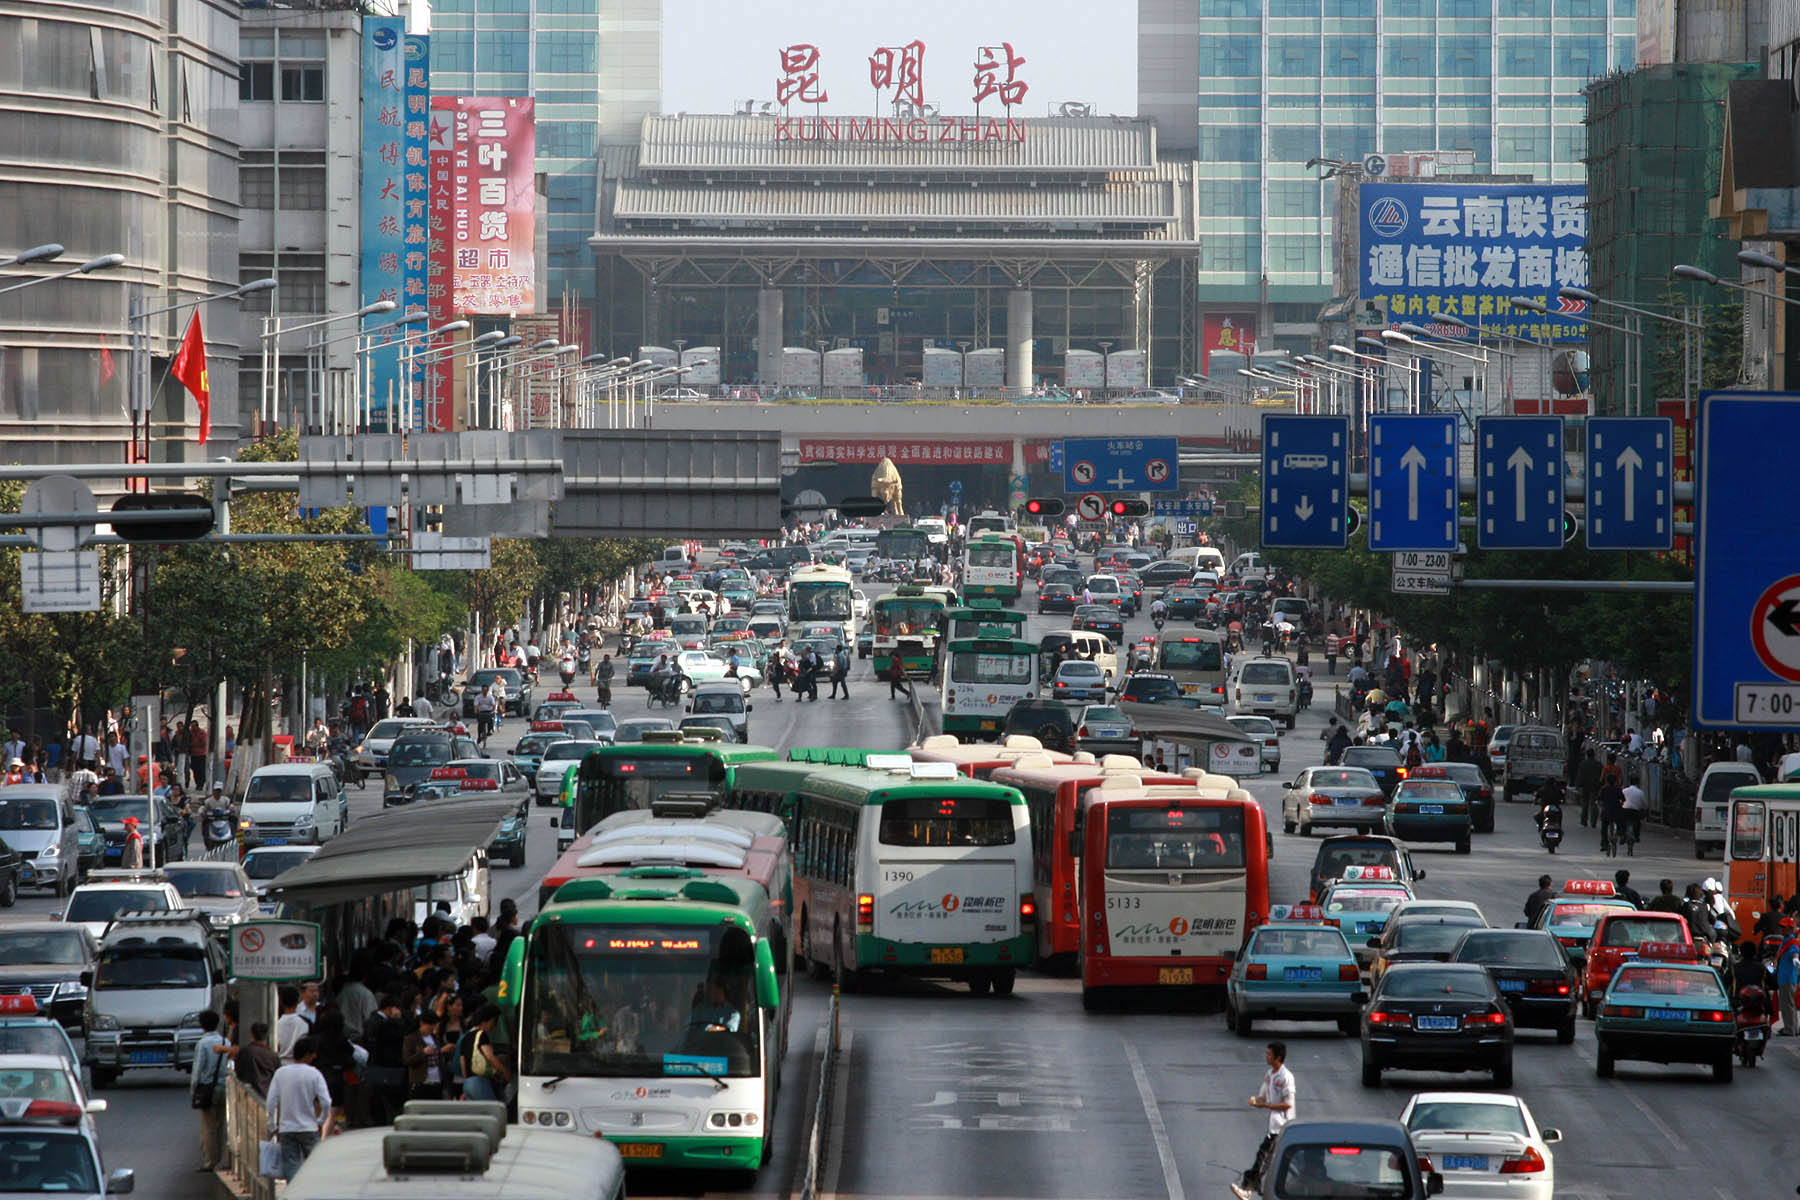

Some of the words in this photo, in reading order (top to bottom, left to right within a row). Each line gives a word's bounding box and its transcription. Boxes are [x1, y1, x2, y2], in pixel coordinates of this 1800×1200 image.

[776, 40, 1029, 107] 昆明站
[456, 112, 468, 141] SAN
[776, 118, 840, 142] KUN
[850, 118, 928, 142] MING
[939, 118, 1026, 142] ZHAN
[456, 150, 468, 168] YE
[478, 110, 508, 240] 三叶百货
[456, 176, 468, 202] BAI
[456, 209, 468, 240] HUO
[1420, 196, 1588, 238] 云南联贸
[458, 249, 510, 269] 超市
[1369, 244, 1589, 288] 通信批发商城
[1374, 294, 1547, 316] 场内有大型茶叶市场
[1177, 521, 1197, 534] 出口
[1396, 575, 1445, 589] 公交车除
[885, 871, 914, 882] 1390
[1364, 867, 1391, 880] 世博
[1107, 897, 1141, 909] 5133
